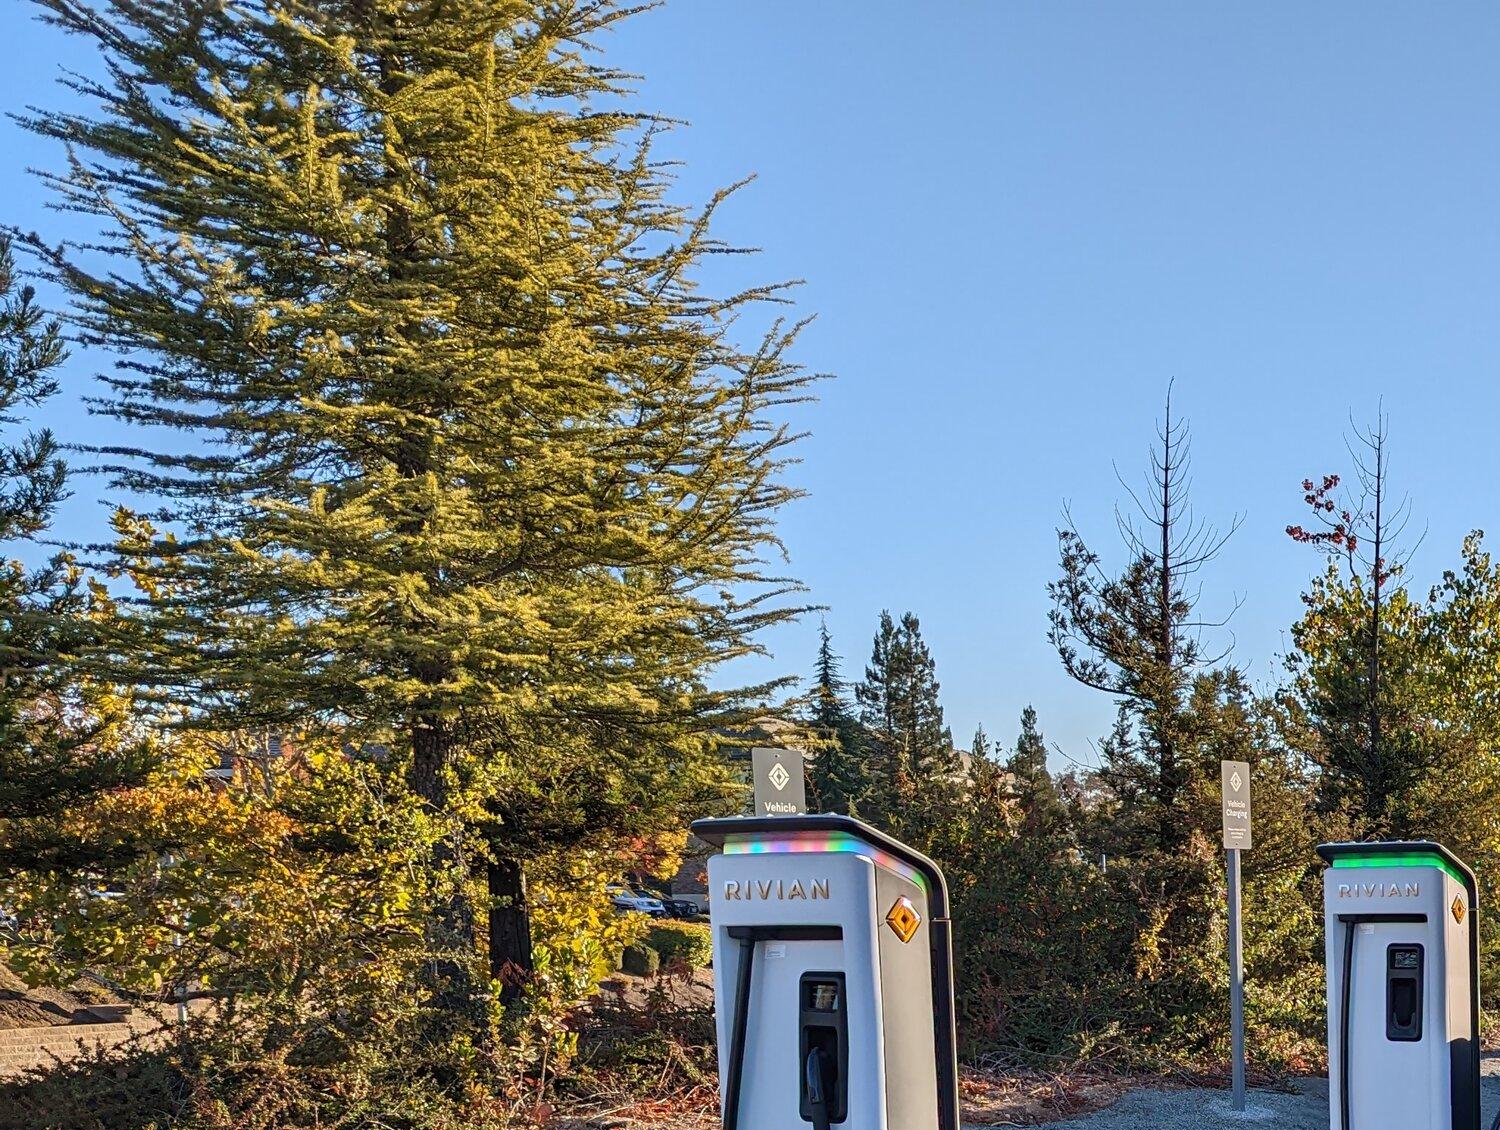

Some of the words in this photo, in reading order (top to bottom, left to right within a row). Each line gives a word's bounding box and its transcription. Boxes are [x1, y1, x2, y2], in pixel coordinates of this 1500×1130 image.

[764, 802, 797, 813] Vehicle
[724, 879, 829, 900] RIVIAN
[1338, 883, 1420, 898] RIVIAN
